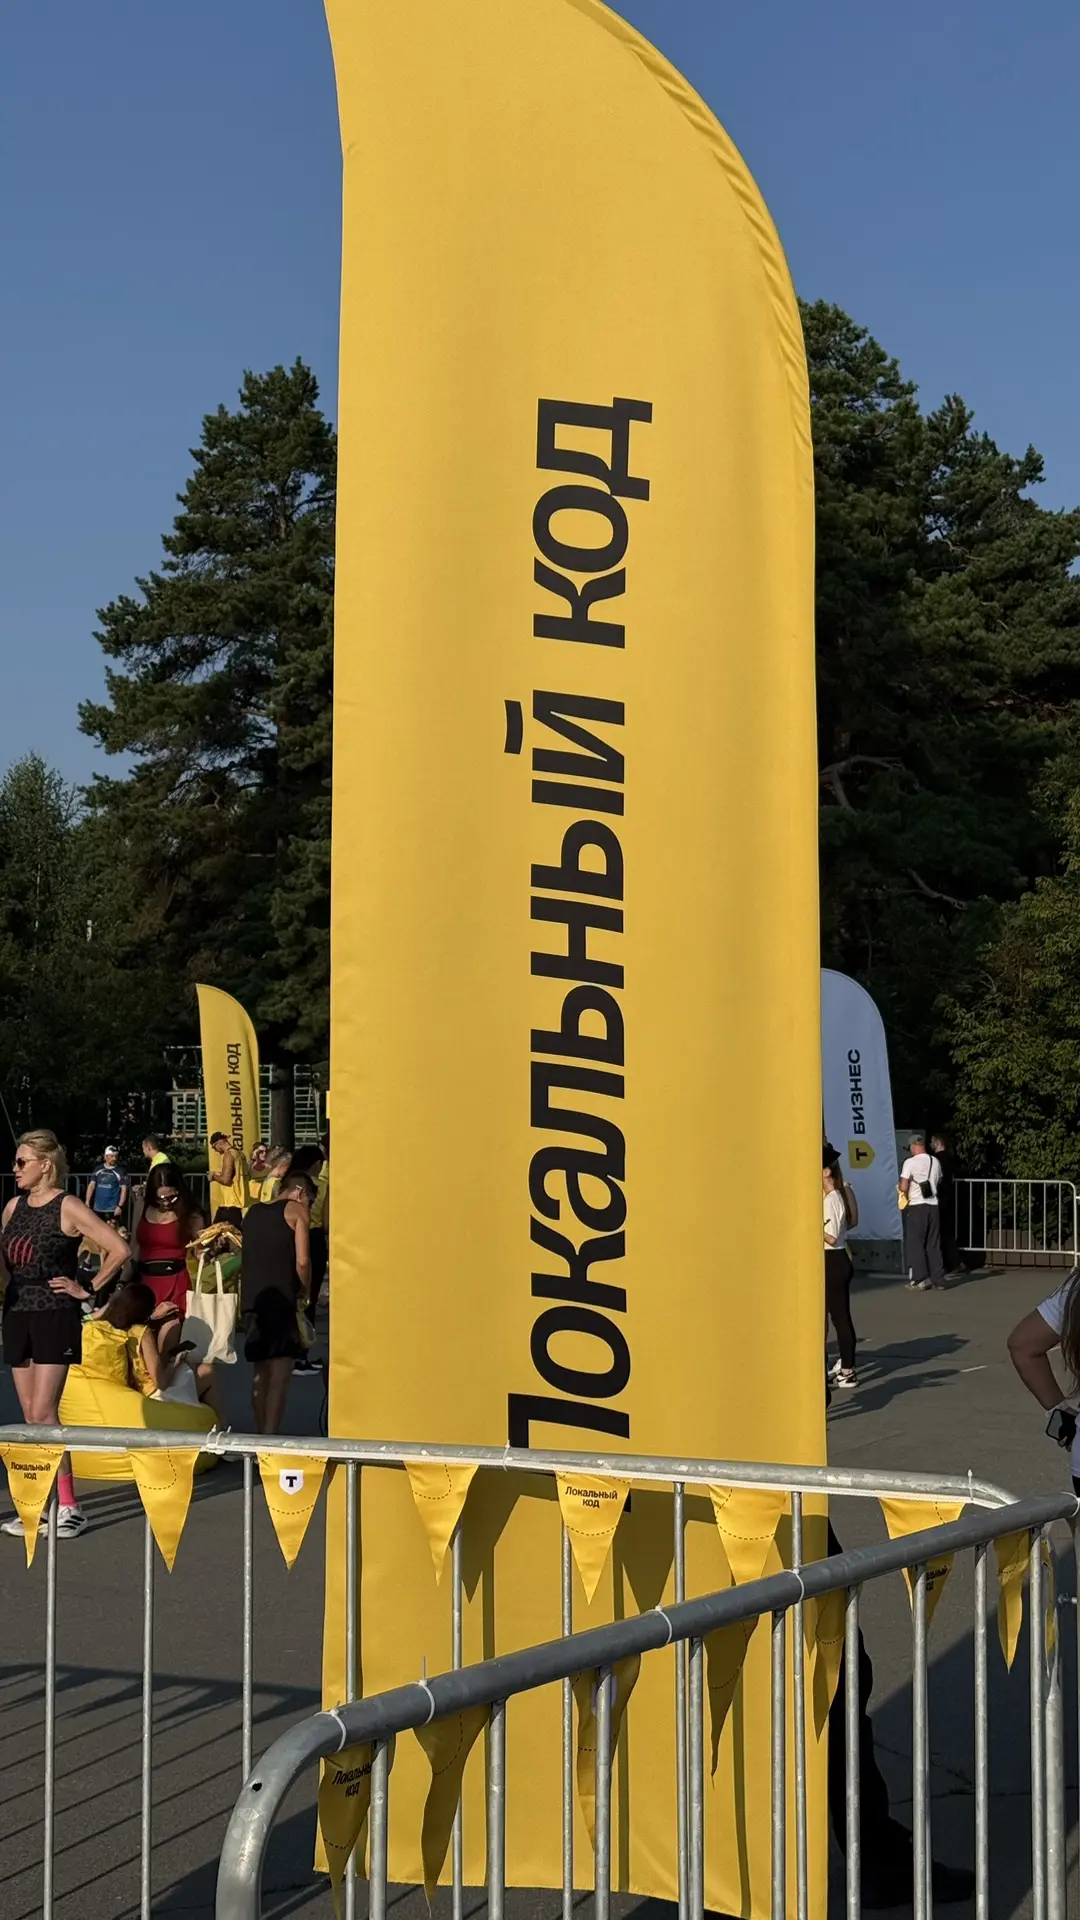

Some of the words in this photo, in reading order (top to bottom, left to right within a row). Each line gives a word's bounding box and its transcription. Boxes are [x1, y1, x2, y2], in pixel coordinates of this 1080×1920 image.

[532, 396, 653, 649] код
[227, 1043, 241, 1075] код
[847, 1049, 866, 1135] БИЗНЕС
[10, 1461, 51, 1472] Локальный
[24, 1472, 37, 1481] код
[565, 1486, 618, 1500] Локальный
[582, 1498, 600, 1509] код
